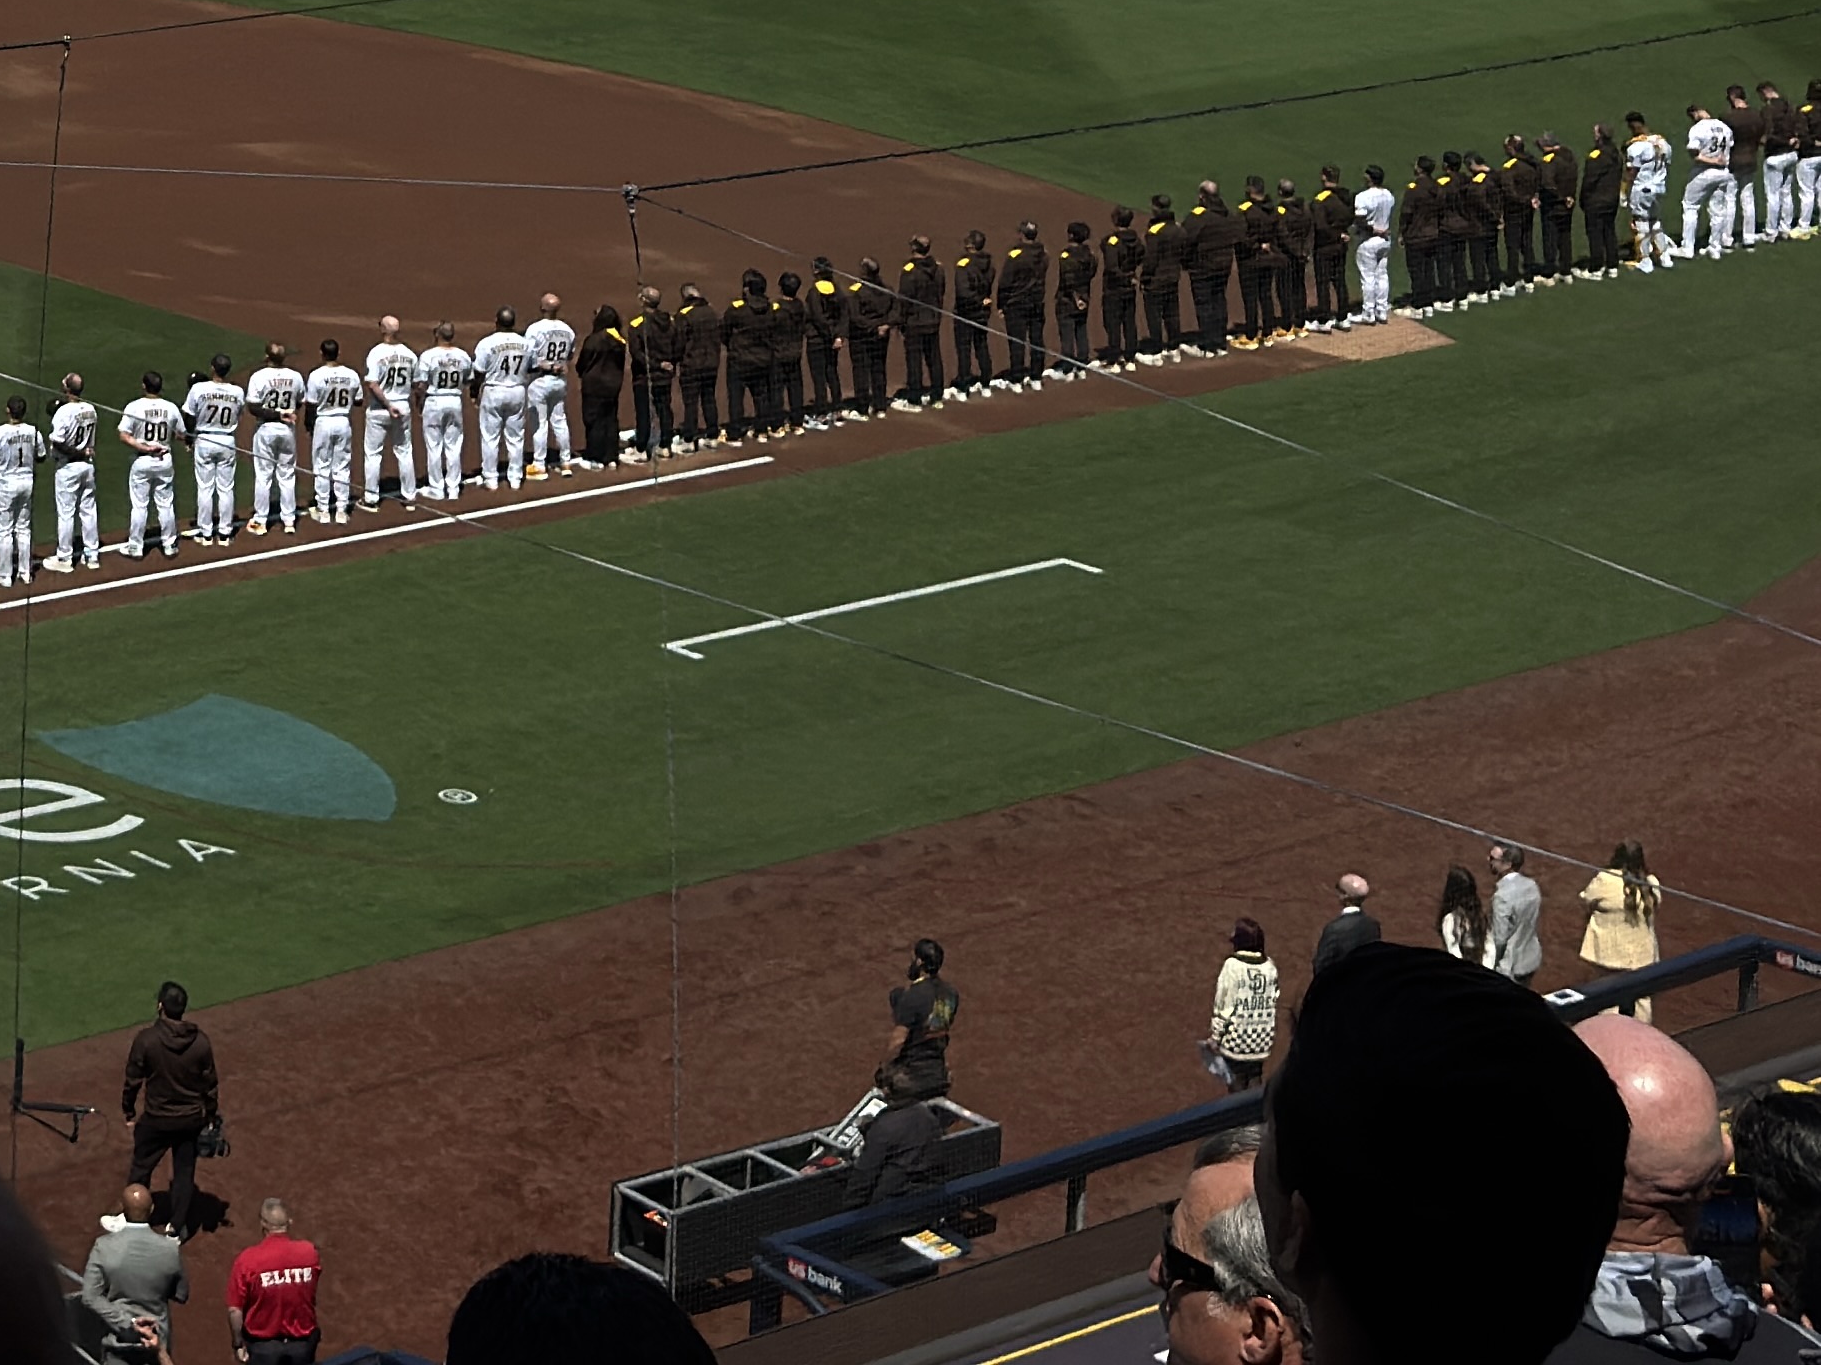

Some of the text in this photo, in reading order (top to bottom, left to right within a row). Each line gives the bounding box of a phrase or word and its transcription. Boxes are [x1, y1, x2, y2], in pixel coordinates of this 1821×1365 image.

[1709, 134, 1727, 153] 34
[546, 341, 567, 361] 82
[500, 355, 524, 375] 47
[384, 367, 407, 388] 85
[437, 370, 460, 389] 89
[326, 387, 349, 407] 46
[207, 405, 232, 427] 70
[75, 422, 95, 445] 87
[144, 421, 168, 442] 80
[17, 447, 24, 468] 1
[1235, 995, 1278, 1012] PADRES
[260, 1265, 314, 1288] ELITE
[788, 1259, 843, 1294] us bank
